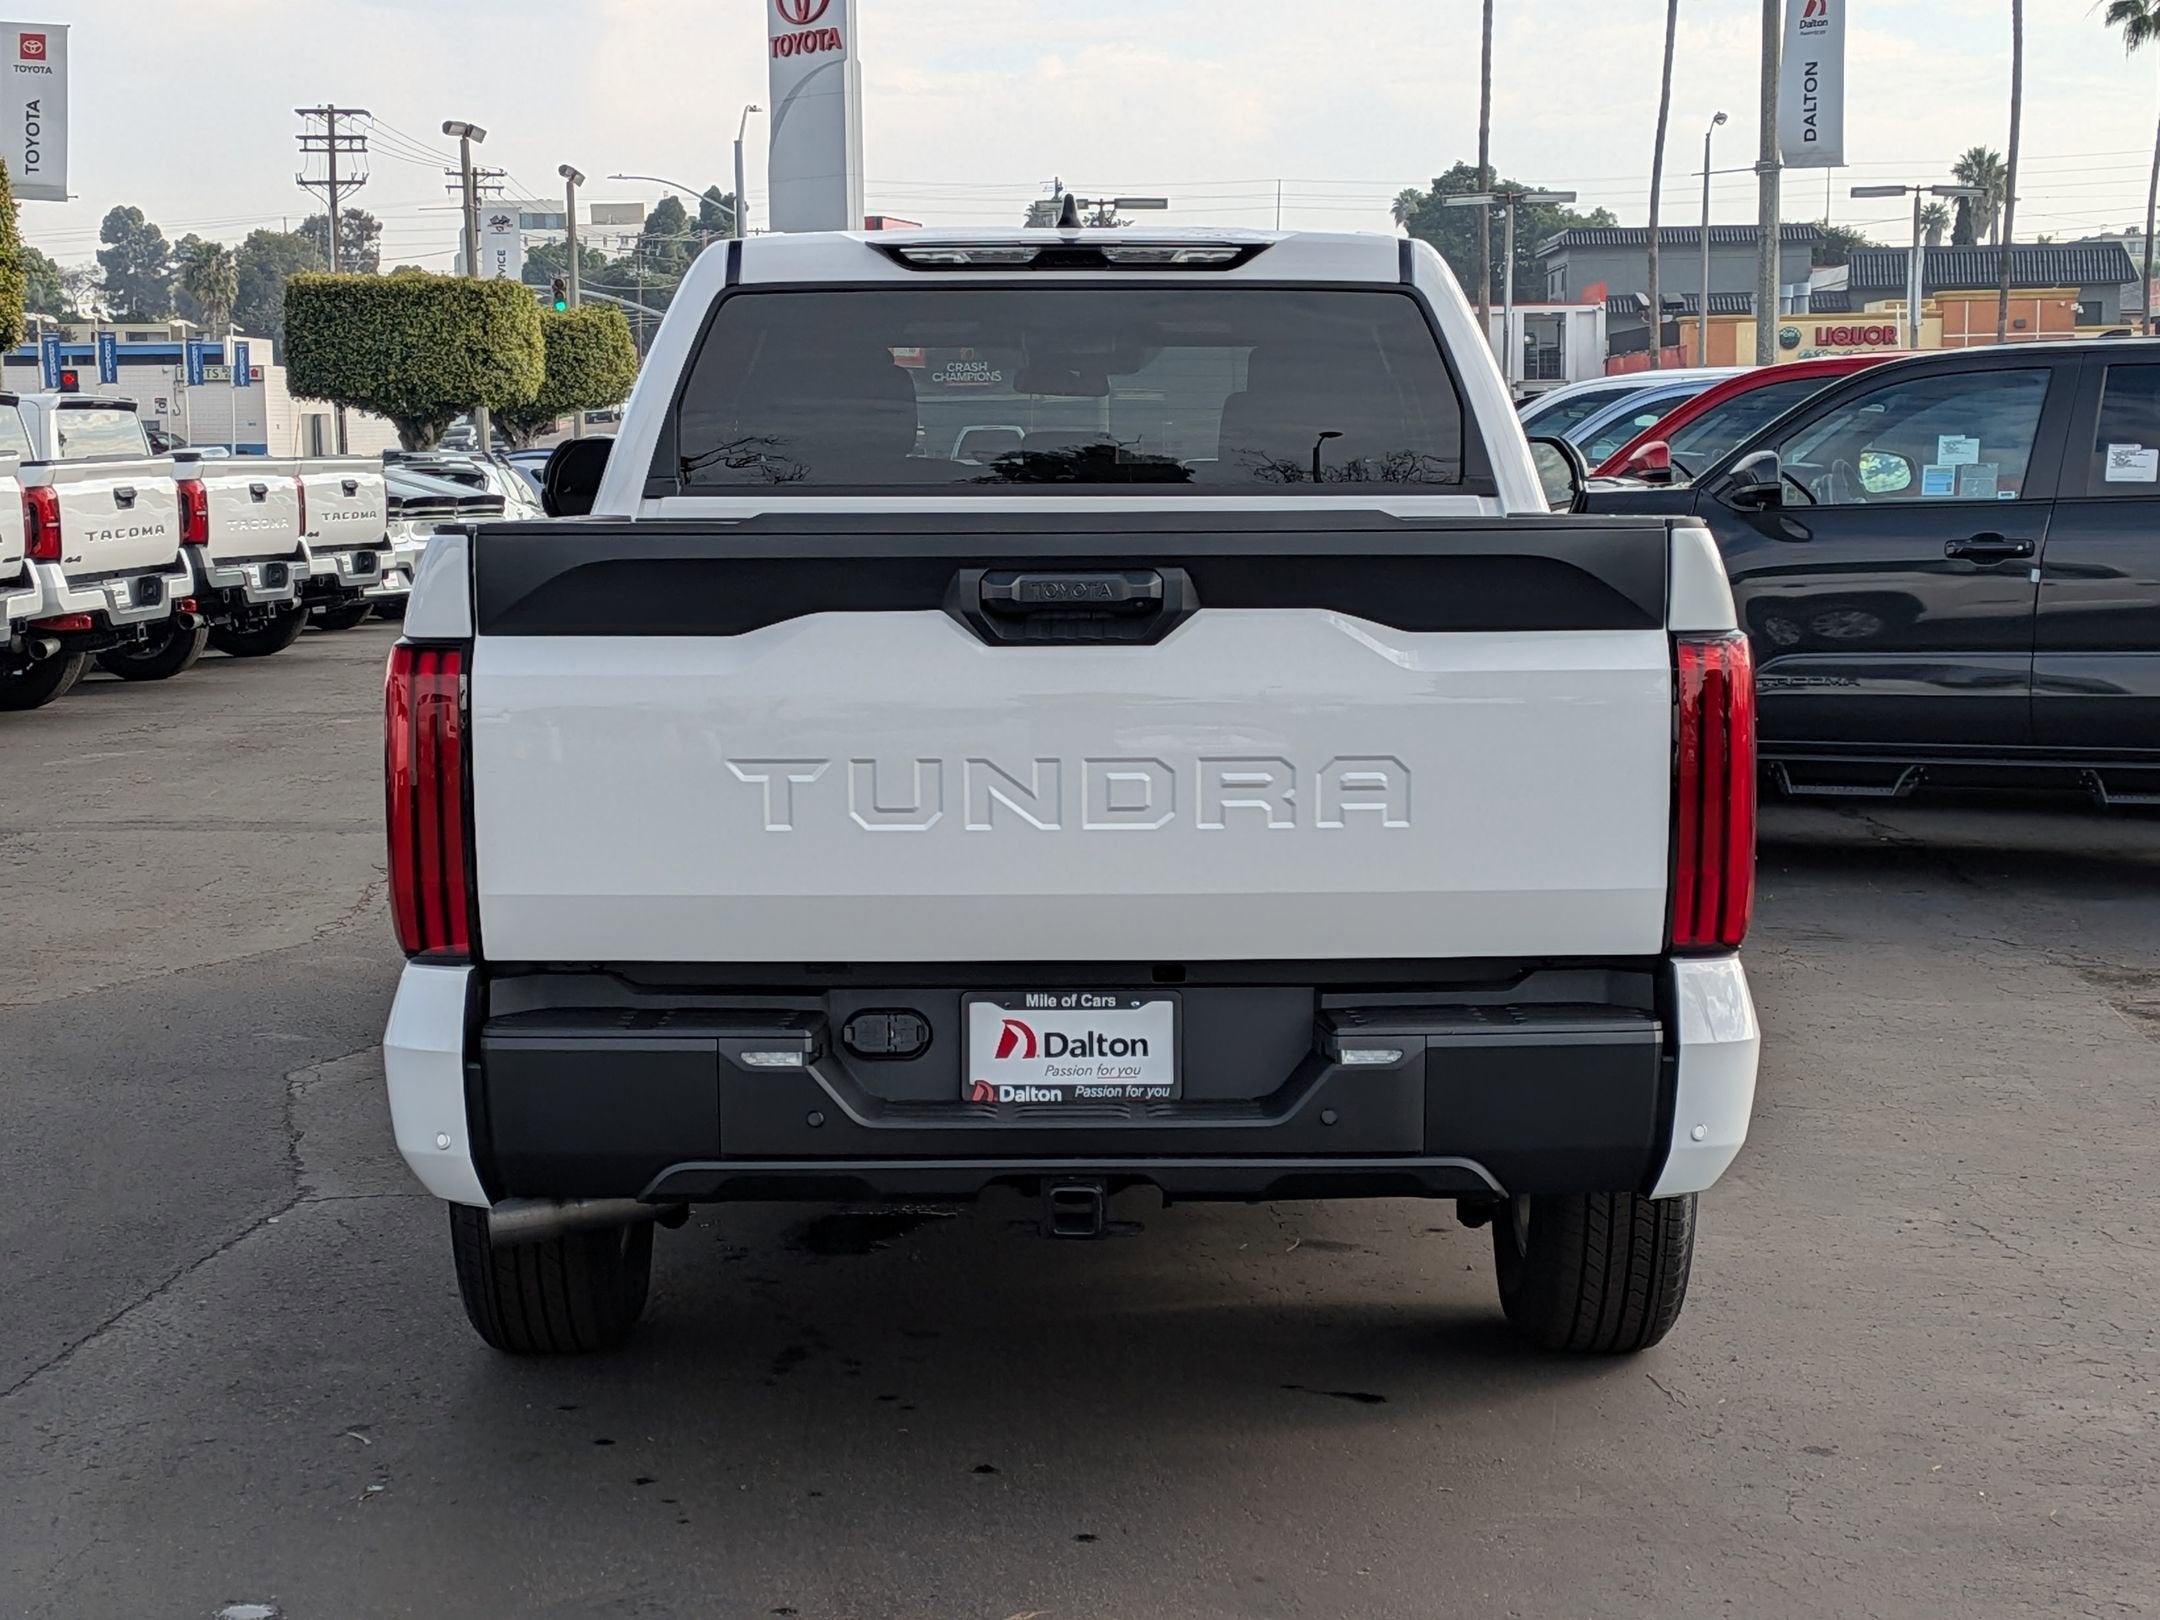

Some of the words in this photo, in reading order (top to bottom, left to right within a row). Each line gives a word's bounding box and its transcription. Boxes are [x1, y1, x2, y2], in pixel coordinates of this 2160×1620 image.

[1799, 20, 1828, 29] Dalton
[769, 27, 842, 58] TOYOTA
[13, 64, 52, 74] TOYOTA
[1803, 61, 1818, 142] DALTON
[25, 99, 41, 175] TOYOTA
[1815, 325, 1897, 347] LIQUOR
[947, 362, 988, 372] CRASH
[932, 370, 1002, 382] CHAMPIONS
[321, 510, 377, 521] TACOMA
[226, 518, 289, 531] TACOMA
[85, 524, 165, 542] TACOMA
[1030, 583, 1113, 599] TOYOTA
[725, 756, 1412, 832] TUNDRA
[1026, 994, 1057, 1008] Mile
[1061, 994, 1077, 1007] of
[1081, 995, 1116, 1007] Cars
[1044, 1031, 1149, 1059] Dalton
[1044, 1064, 1092, 1077] Passion
[1097, 1064, 1117, 1077] for
[1117, 1066, 1142, 1077] you
[1000, 1086, 1063, 1102] Dalton
[1074, 1085, 1123, 1098] Passion
[1125, 1085, 1145, 1098] for
[1146, 1087, 1171, 1099] you
